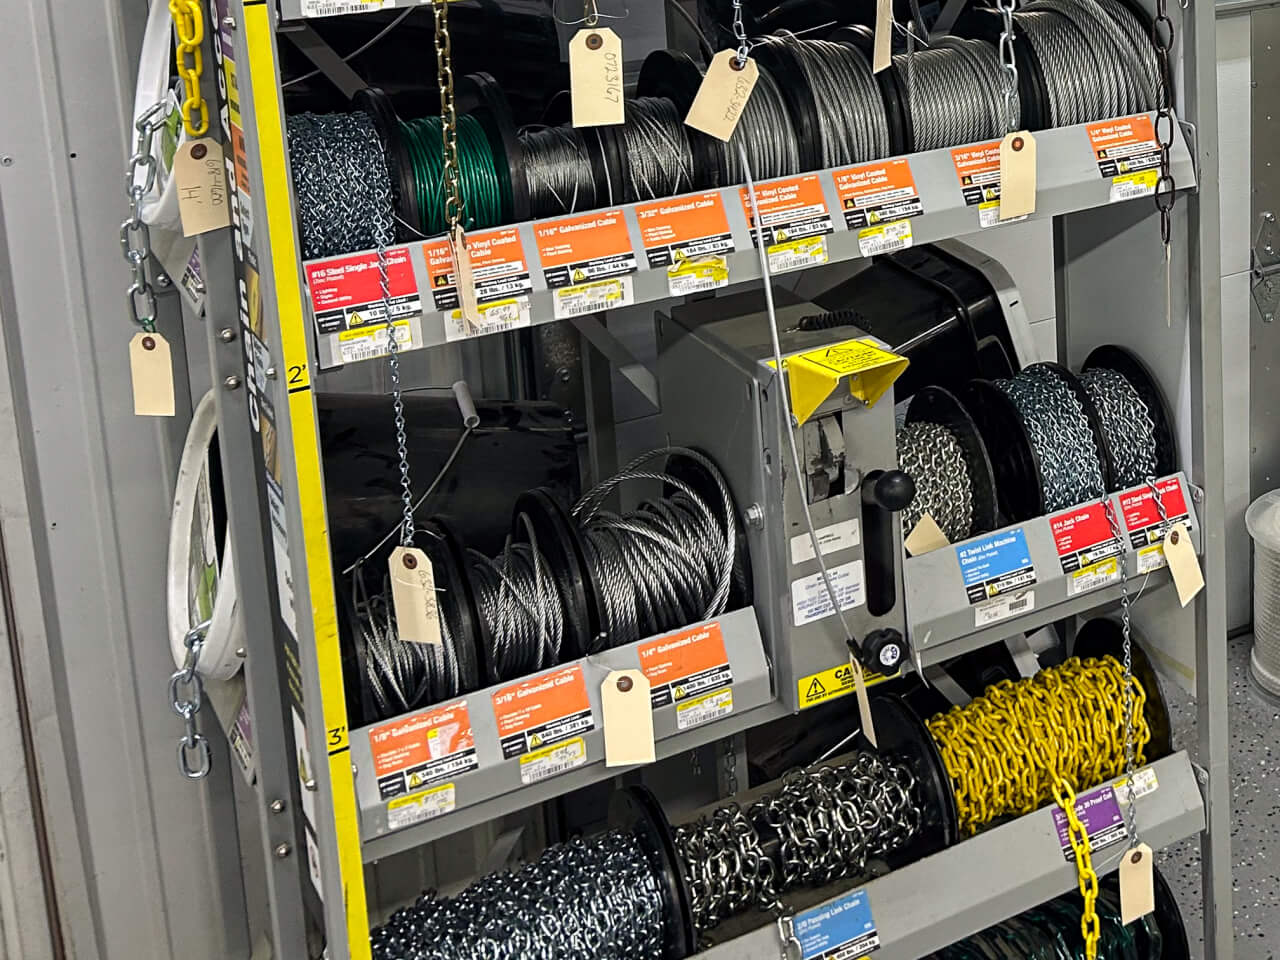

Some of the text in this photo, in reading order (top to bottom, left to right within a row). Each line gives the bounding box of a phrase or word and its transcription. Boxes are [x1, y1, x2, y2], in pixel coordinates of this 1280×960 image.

[851, 171, 866, 181] Vinyl
[870, 175, 888, 185] Cable
[780, 192, 798, 202] Cable
[659, 199, 715, 215] Galvanized Cable
[559, 221, 596, 234] Galvanized
[597, 217, 617, 228] Cable
[472, 235, 517, 249] Vinyl Coated
[470, 248, 492, 258] Cable
[326, 266, 345, 277] Steel
[345, 262, 368, 275] Single
[224, 155, 262, 433] Chain and
[1063, 518, 1075, 527] Jack
[1075, 514, 1090, 523] Chain
[967, 546, 982, 556] Twist
[982, 543, 994, 552] Link
[961, 556, 977, 566] Chain
[657, 637, 691, 654] Galvanized
[692, 632, 710, 644] Cable
[555, 673, 574, 686] Cable
[392, 720, 433, 738] Galvanized
[433, 713, 455, 724] Cable
[830, 905, 844, 916] Link
[843, 898, 861, 911] Chain
